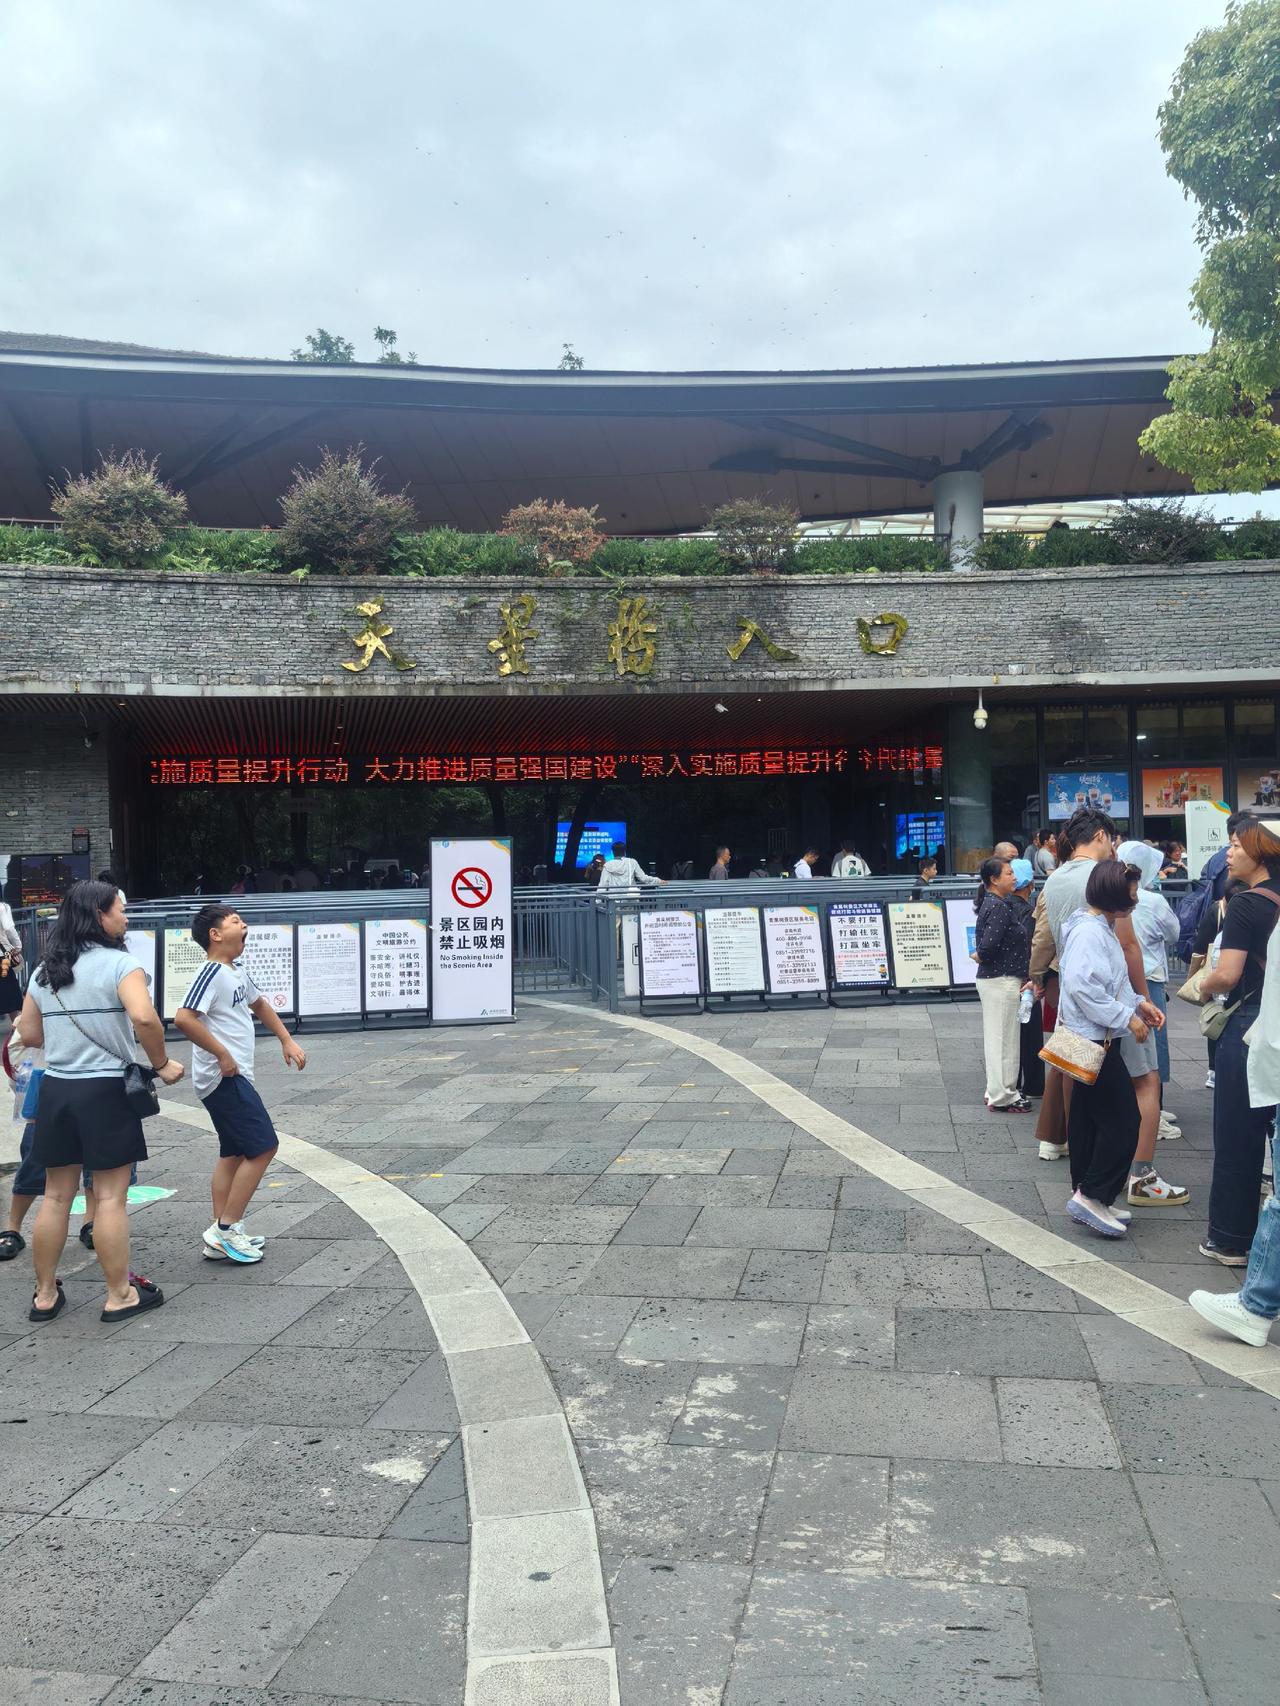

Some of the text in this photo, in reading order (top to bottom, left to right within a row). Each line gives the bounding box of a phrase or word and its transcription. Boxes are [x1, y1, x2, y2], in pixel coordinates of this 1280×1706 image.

[439, 916, 504, 932] 景区园内
[838, 916, 878, 924] 不要打架
[382, 931, 409, 939] 中国公民
[839, 928, 879, 936] 打输住院
[439, 934, 505, 950] 禁止吸烟
[840, 941, 881, 949] 打赢坐牢
[451, 953, 482, 962] Smoking
